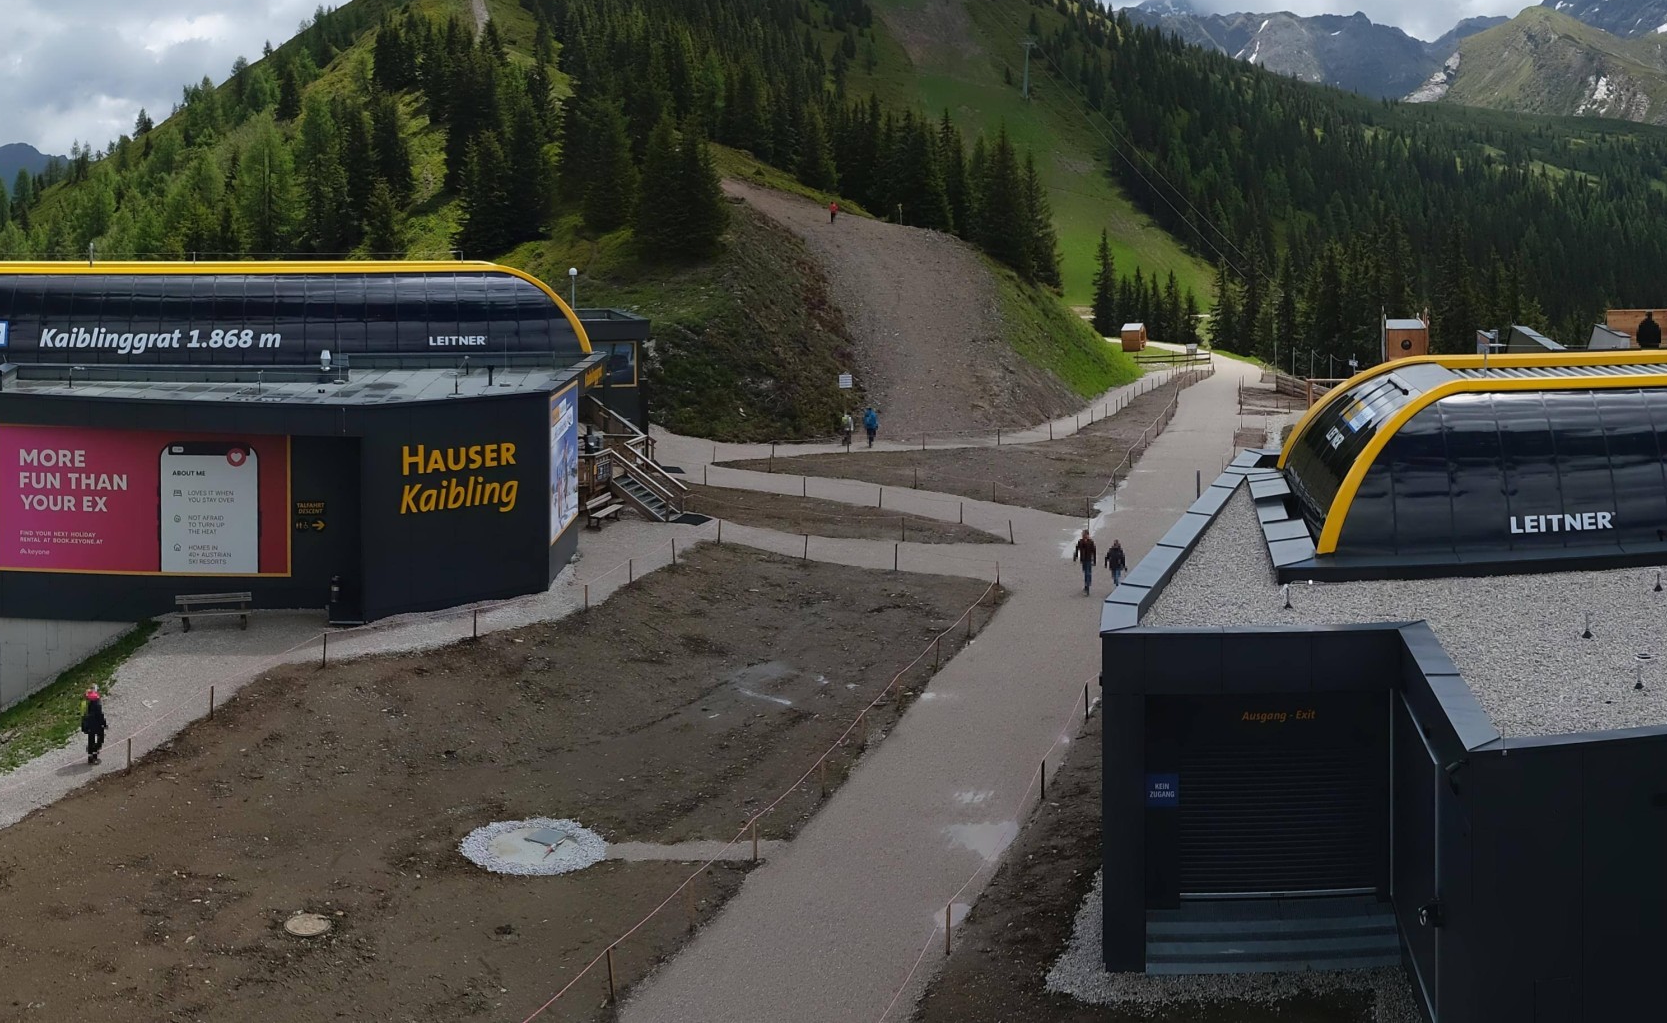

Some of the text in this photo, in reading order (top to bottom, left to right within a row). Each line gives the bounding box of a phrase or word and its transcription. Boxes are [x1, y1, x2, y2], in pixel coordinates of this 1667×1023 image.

[39, 328, 282, 354] Kaiblinggrat 1.868 m
[429, 336, 486, 346] LEITNER
[19, 449, 86, 467] MORE
[402, 442, 517, 476] HAUSER
[19, 472, 128, 490] FUN THAN
[20, 494, 108, 512] YOUR EX
[400, 476, 519, 515] Kaibling
[1510, 511, 1614, 534] LEITNER
[28, 548, 50, 556] keyone
[1241, 711, 1287, 723] Ausgang
[1295, 709, 1316, 720] Exit
